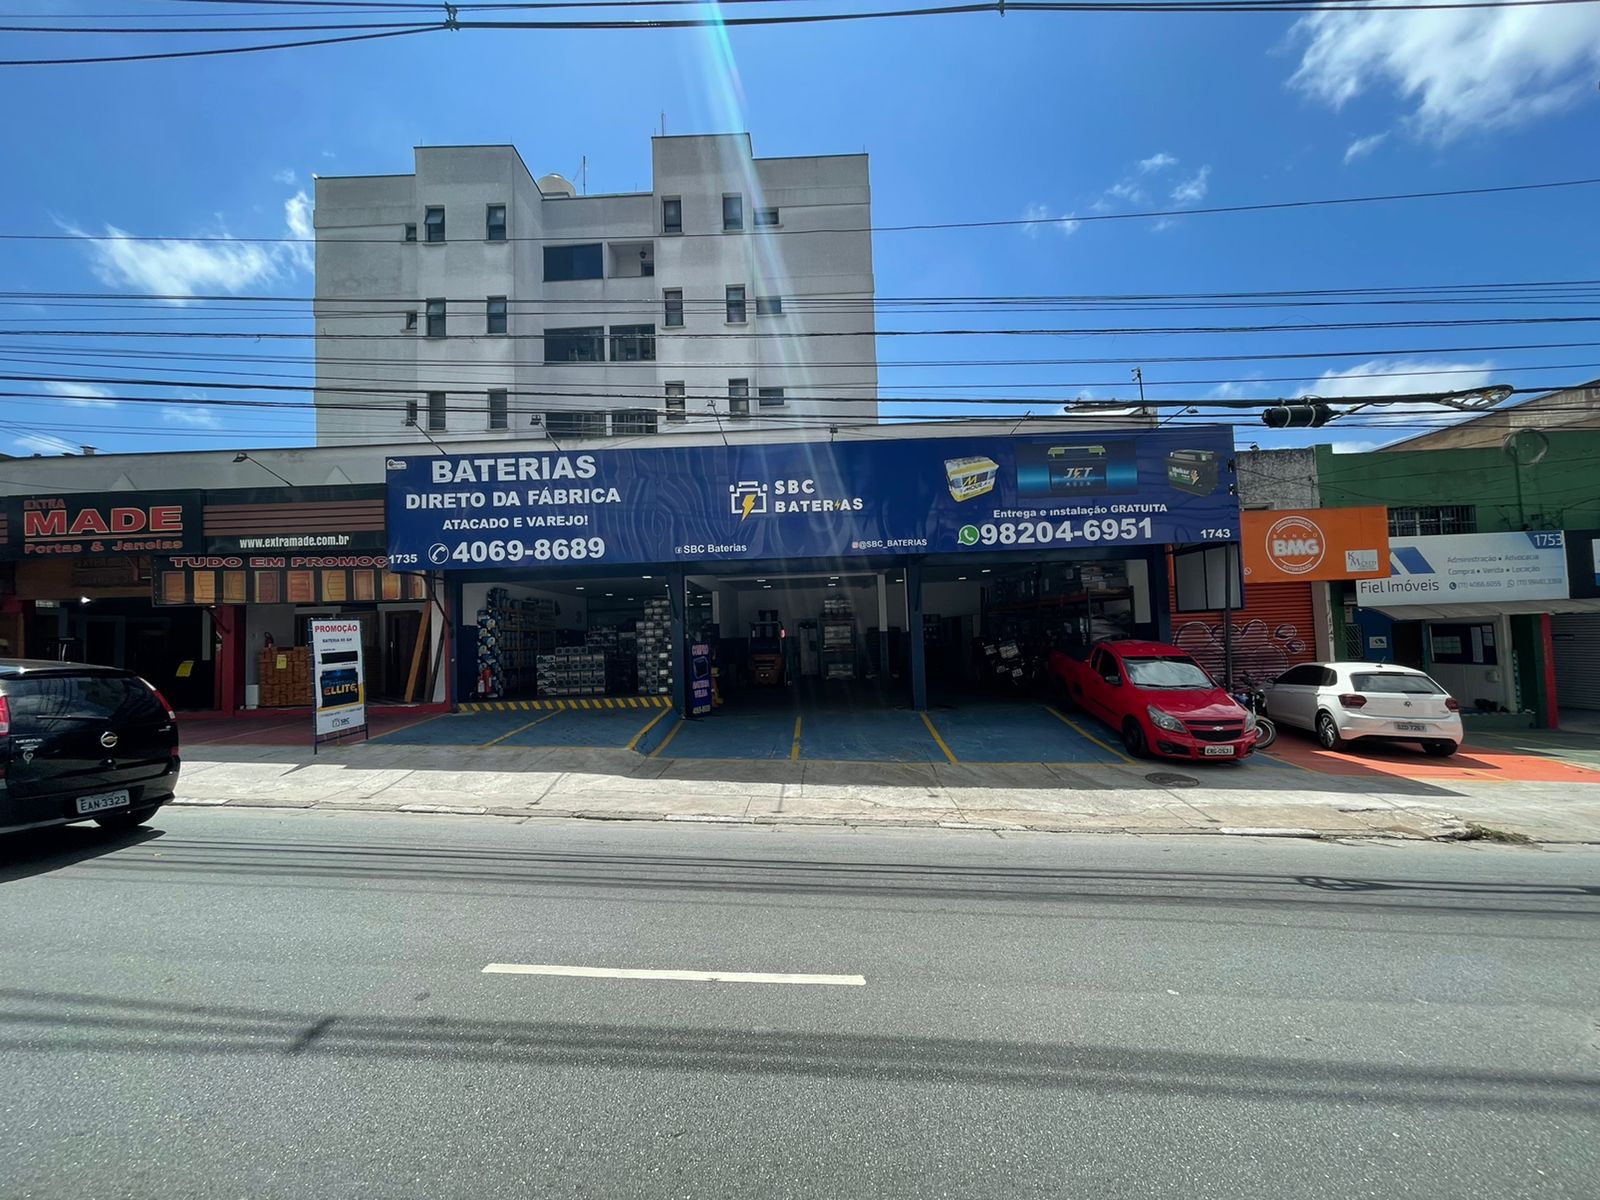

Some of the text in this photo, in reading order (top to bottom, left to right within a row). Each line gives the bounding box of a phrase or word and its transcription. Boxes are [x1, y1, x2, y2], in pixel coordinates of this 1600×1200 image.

[432, 455, 597, 484] BATERIAS
[775, 479, 815, 494] SBC
[406, 486, 622, 509] DIRETO DA FÁBRICA
[993, 509, 1038, 519] Entrega
[1110, 503, 1168, 514] GRATUITA
[24, 505, 184, 537] MADE
[443, 515, 589, 530] ATACADO E VAREJO!
[980, 517, 1152, 545] 98204-6951
[1200, 528, 1231, 539] 1743
[24, 539, 184, 554] Portas & Janelas
[240, 534, 349, 549] www.extramade.com.br
[859, 538, 928, 549] @SBC_BATERIAS
[1534, 533, 1562, 546] 1753
[452, 537, 605, 563] 4069-8689
[683, 543, 748, 554] SBC Baterias
[1274, 539, 1319, 557] BMG
[170, 556, 243, 568] TUDO
[250, 556, 286, 568] EM
[388, 553, 418, 564] 1735
[1447, 567, 1475, 576] Compra
[1360, 579, 1439, 594] Fiel Imóveis
[314, 624, 358, 633] PROMOÇÃO
